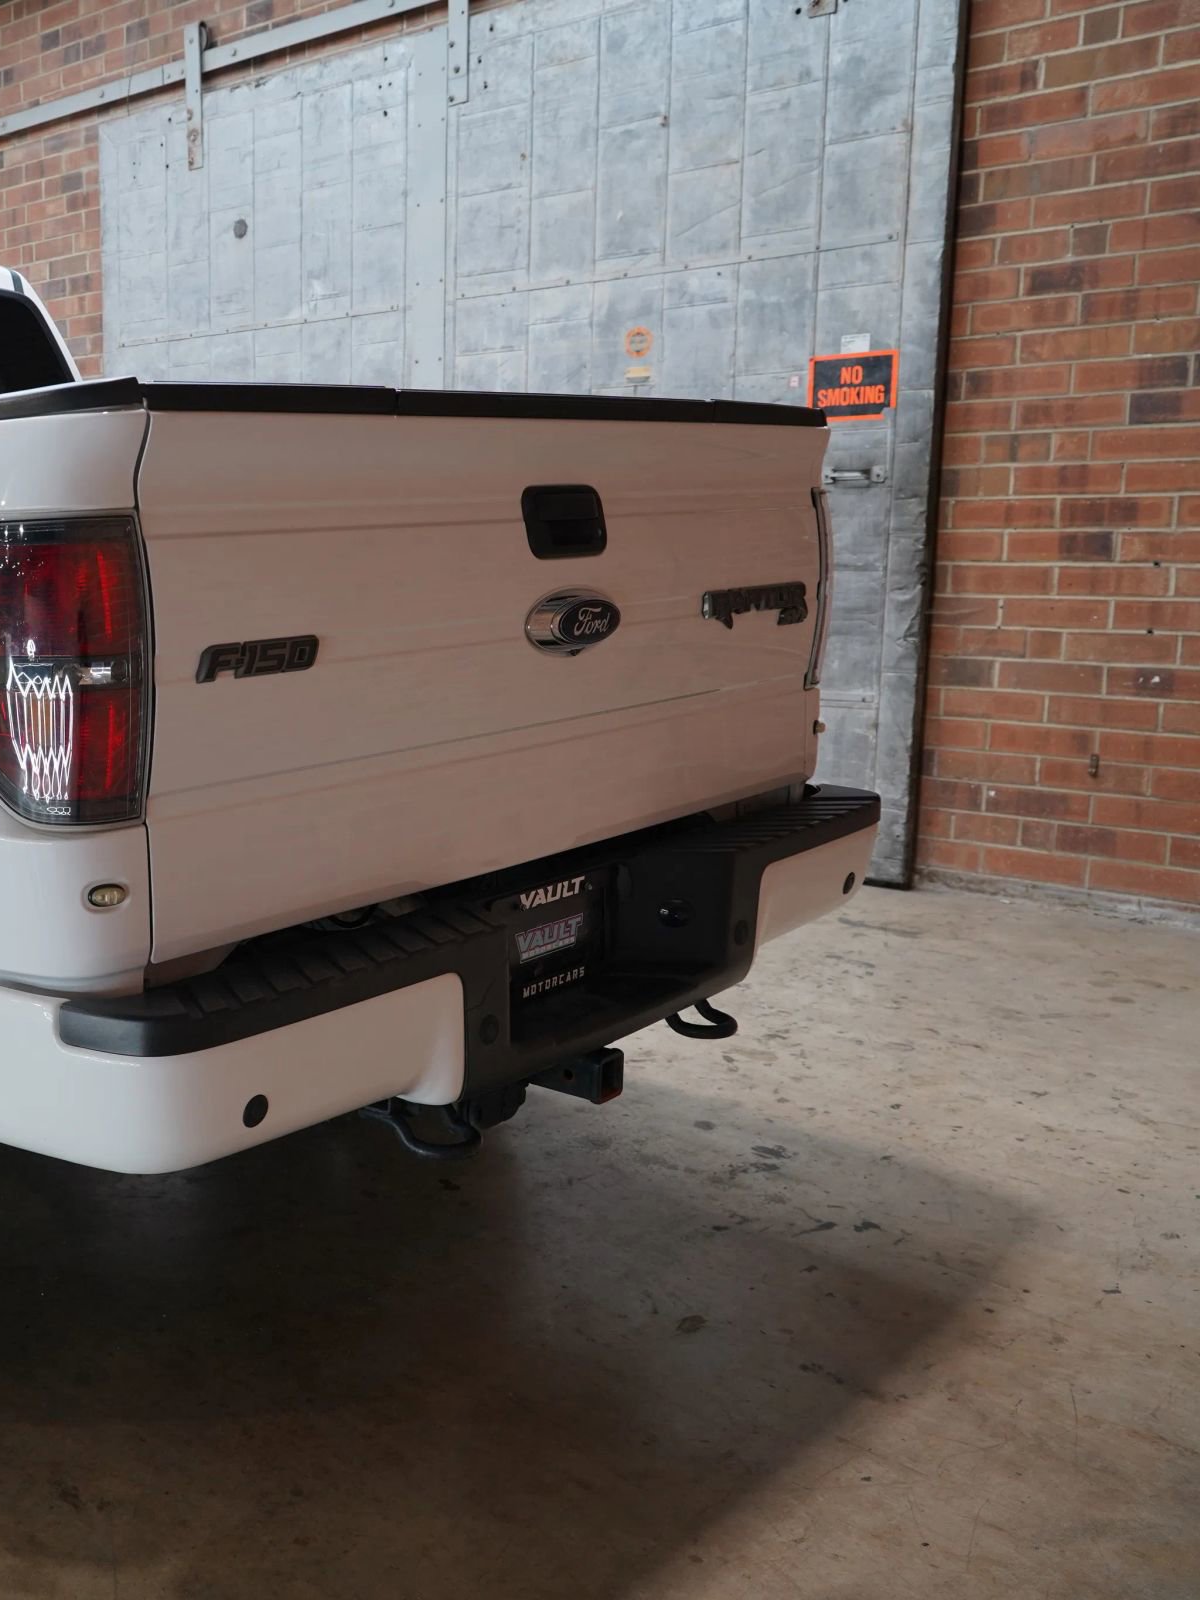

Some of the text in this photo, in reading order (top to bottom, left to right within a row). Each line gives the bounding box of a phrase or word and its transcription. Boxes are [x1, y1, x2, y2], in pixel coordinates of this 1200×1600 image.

[840, 365, 863, 385] NO
[817, 384, 885, 408] SMOKING
[573, 607, 611, 636] Ford
[196, 634, 319, 684] F-150
[519, 875, 585, 910] VAULT
[517, 916, 582, 953] VAULT
[522, 966, 585, 999] MOTORCARS
